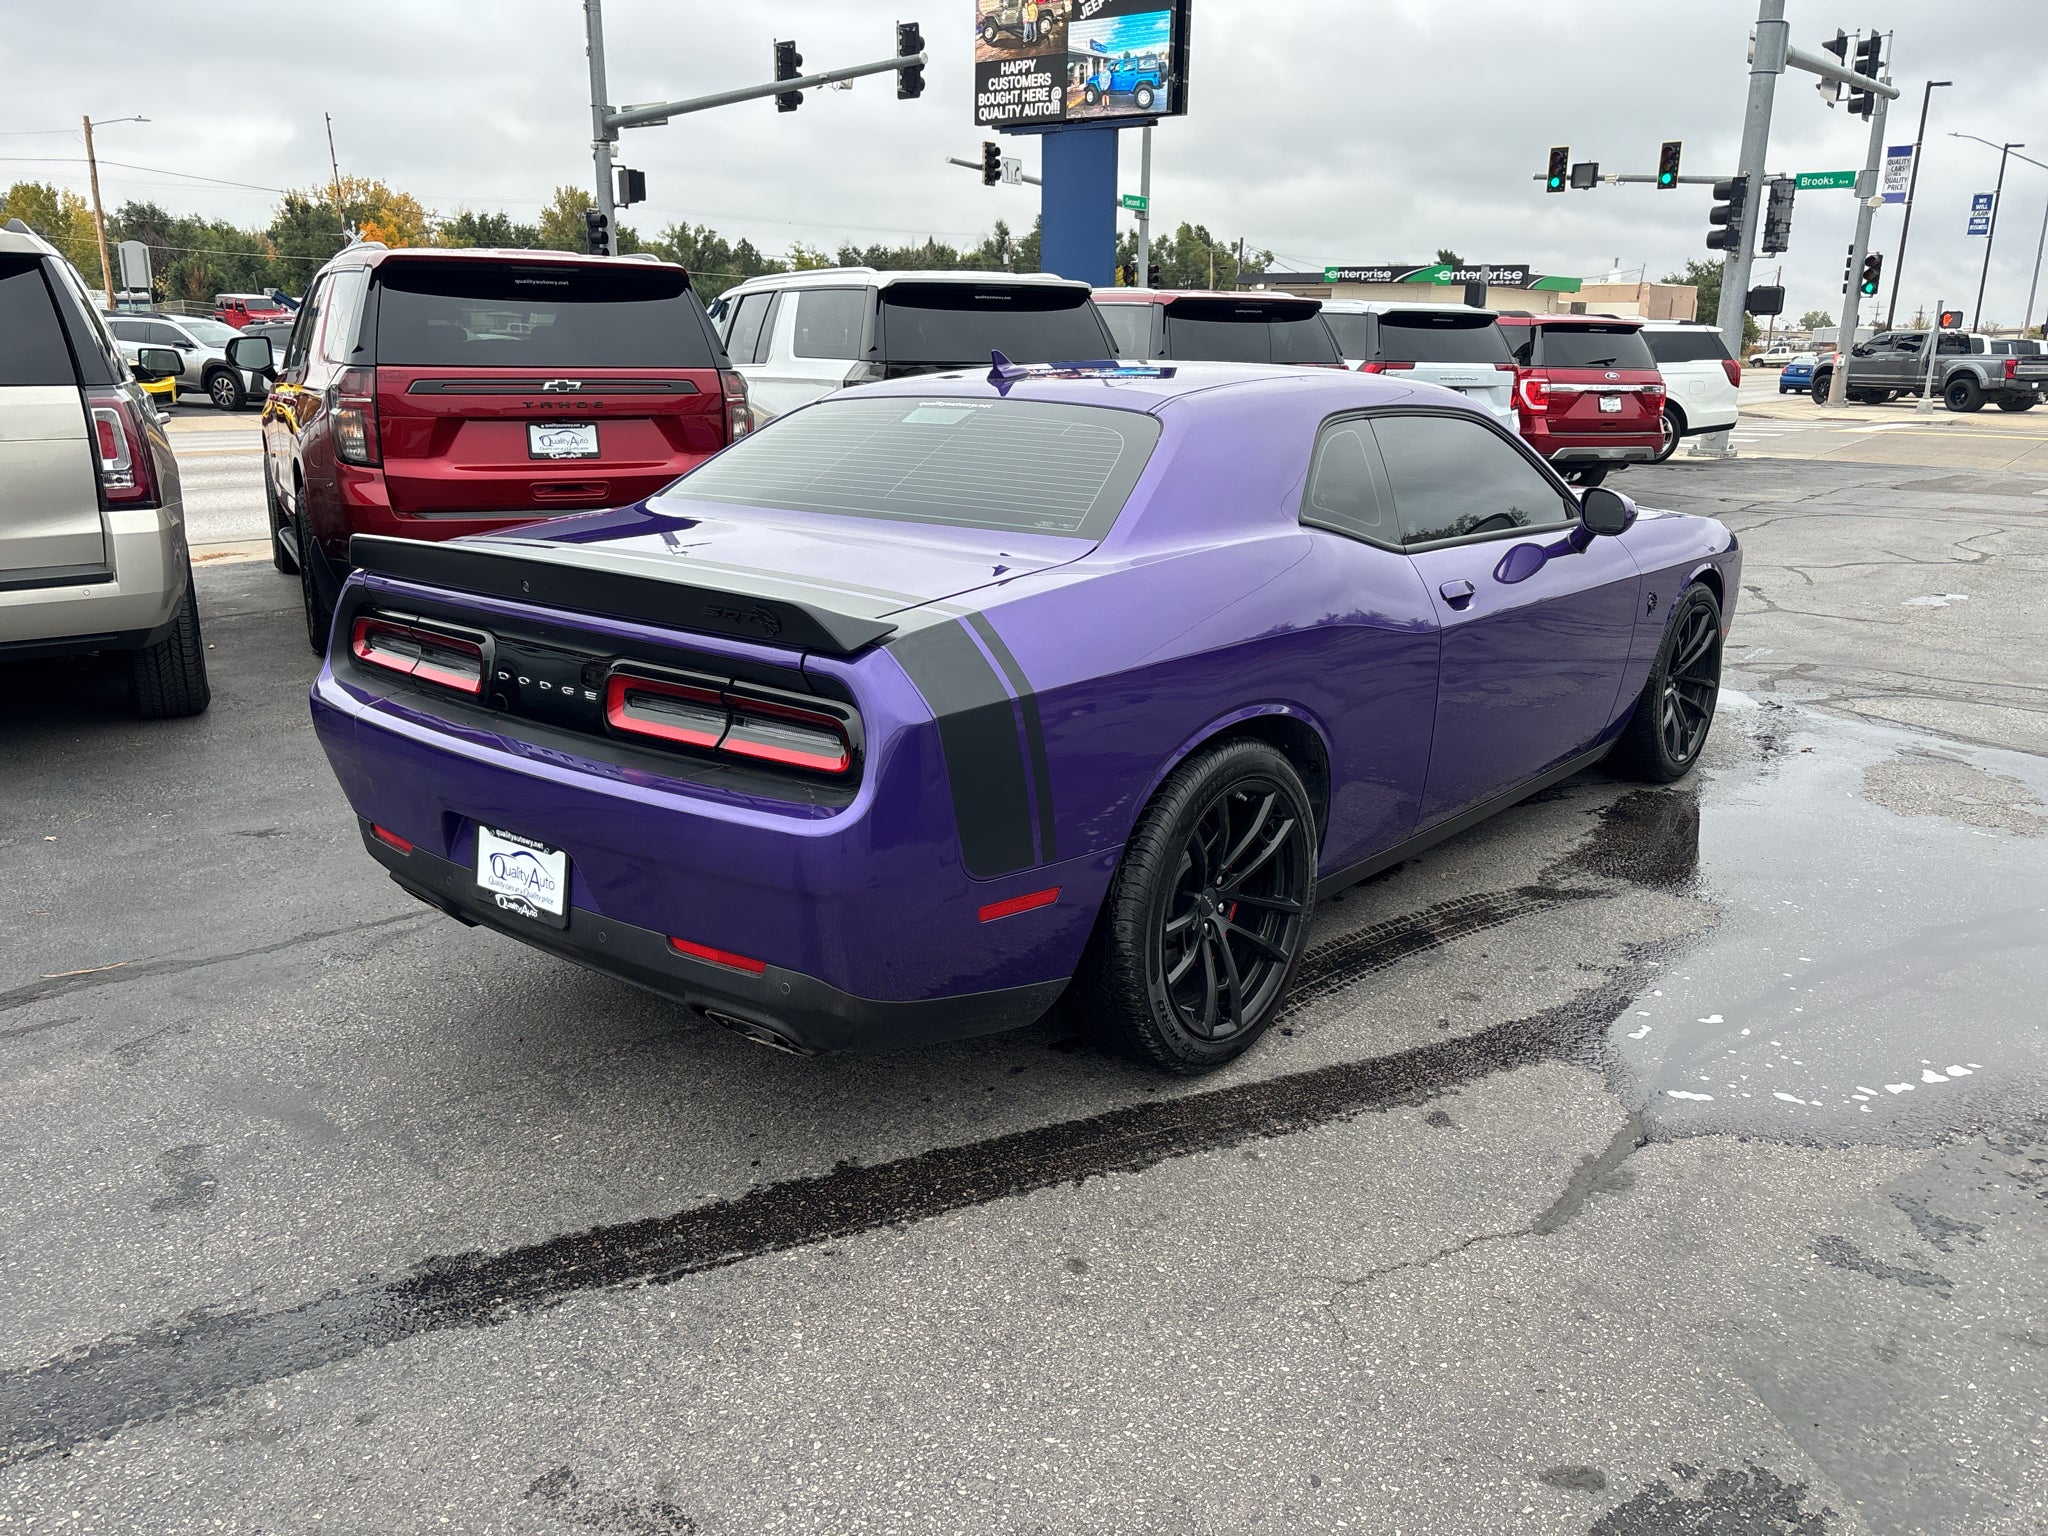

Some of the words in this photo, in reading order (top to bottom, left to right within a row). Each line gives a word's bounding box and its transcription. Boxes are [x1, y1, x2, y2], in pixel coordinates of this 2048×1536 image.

[1000, 59, 1037, 75] HAPPY
[988, 72, 1052, 91] CUSTOMERS
[978, 90, 1020, 106] BOUGHT
[1022, 87, 1050, 102] HERE
[1051, 86, 1062, 102] @
[978, 104, 1022, 121] QUALITY
[1023, 100, 1060, 117] AUTO!!!
[1887, 158, 1911, 166] QUALITY
[1801, 176, 1834, 186] Brooks
[1884, 176, 1908, 184] QUALITY
[1886, 183, 1904, 191] PRICE
[1325, 268, 1392, 280] enterprise
[522, 401, 604, 409] TAHOE
[497, 671, 598, 701] DODGE
[496, 829, 544, 850] qualityautowy.net
[488, 875, 505, 888] Quality
[523, 887, 541, 901] Quality
[541, 895, 554, 906] price
